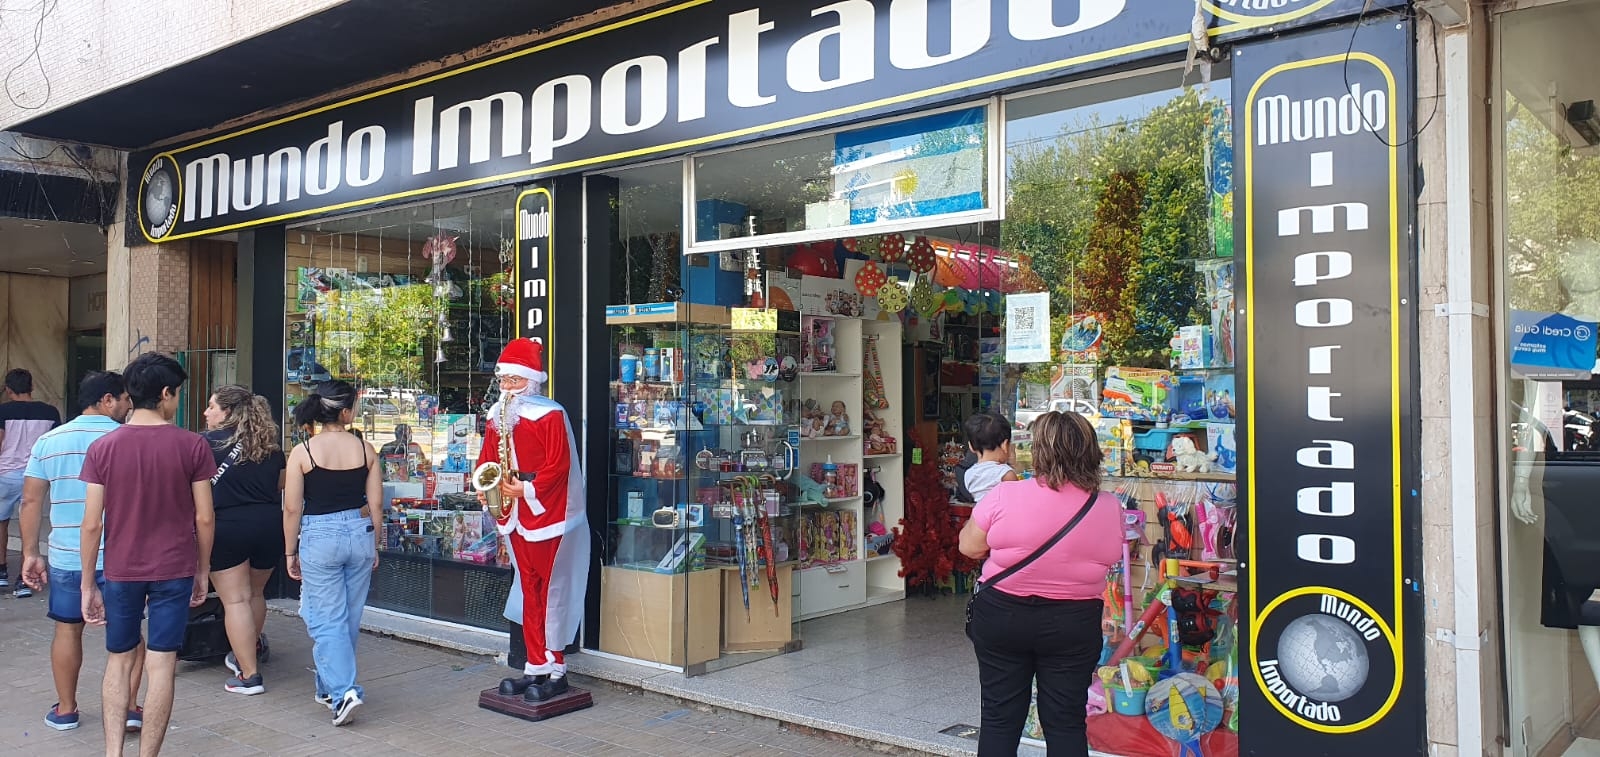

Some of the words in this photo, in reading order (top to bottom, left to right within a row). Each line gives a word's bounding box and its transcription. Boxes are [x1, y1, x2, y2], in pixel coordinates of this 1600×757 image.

[1257, 82, 1386, 146] Mundo
[145, 158, 163, 184] Mundo
[183, 120, 387, 222] Mundo
[150, 203, 177, 238] Importado
[520, 206, 549, 240] Mundo
[1278, 151, 1369, 564] Importado
[209, 462, 229, 486] LOVE
[1320, 593, 1381, 642] Mundo
[1259, 659, 1342, 722] Importado
